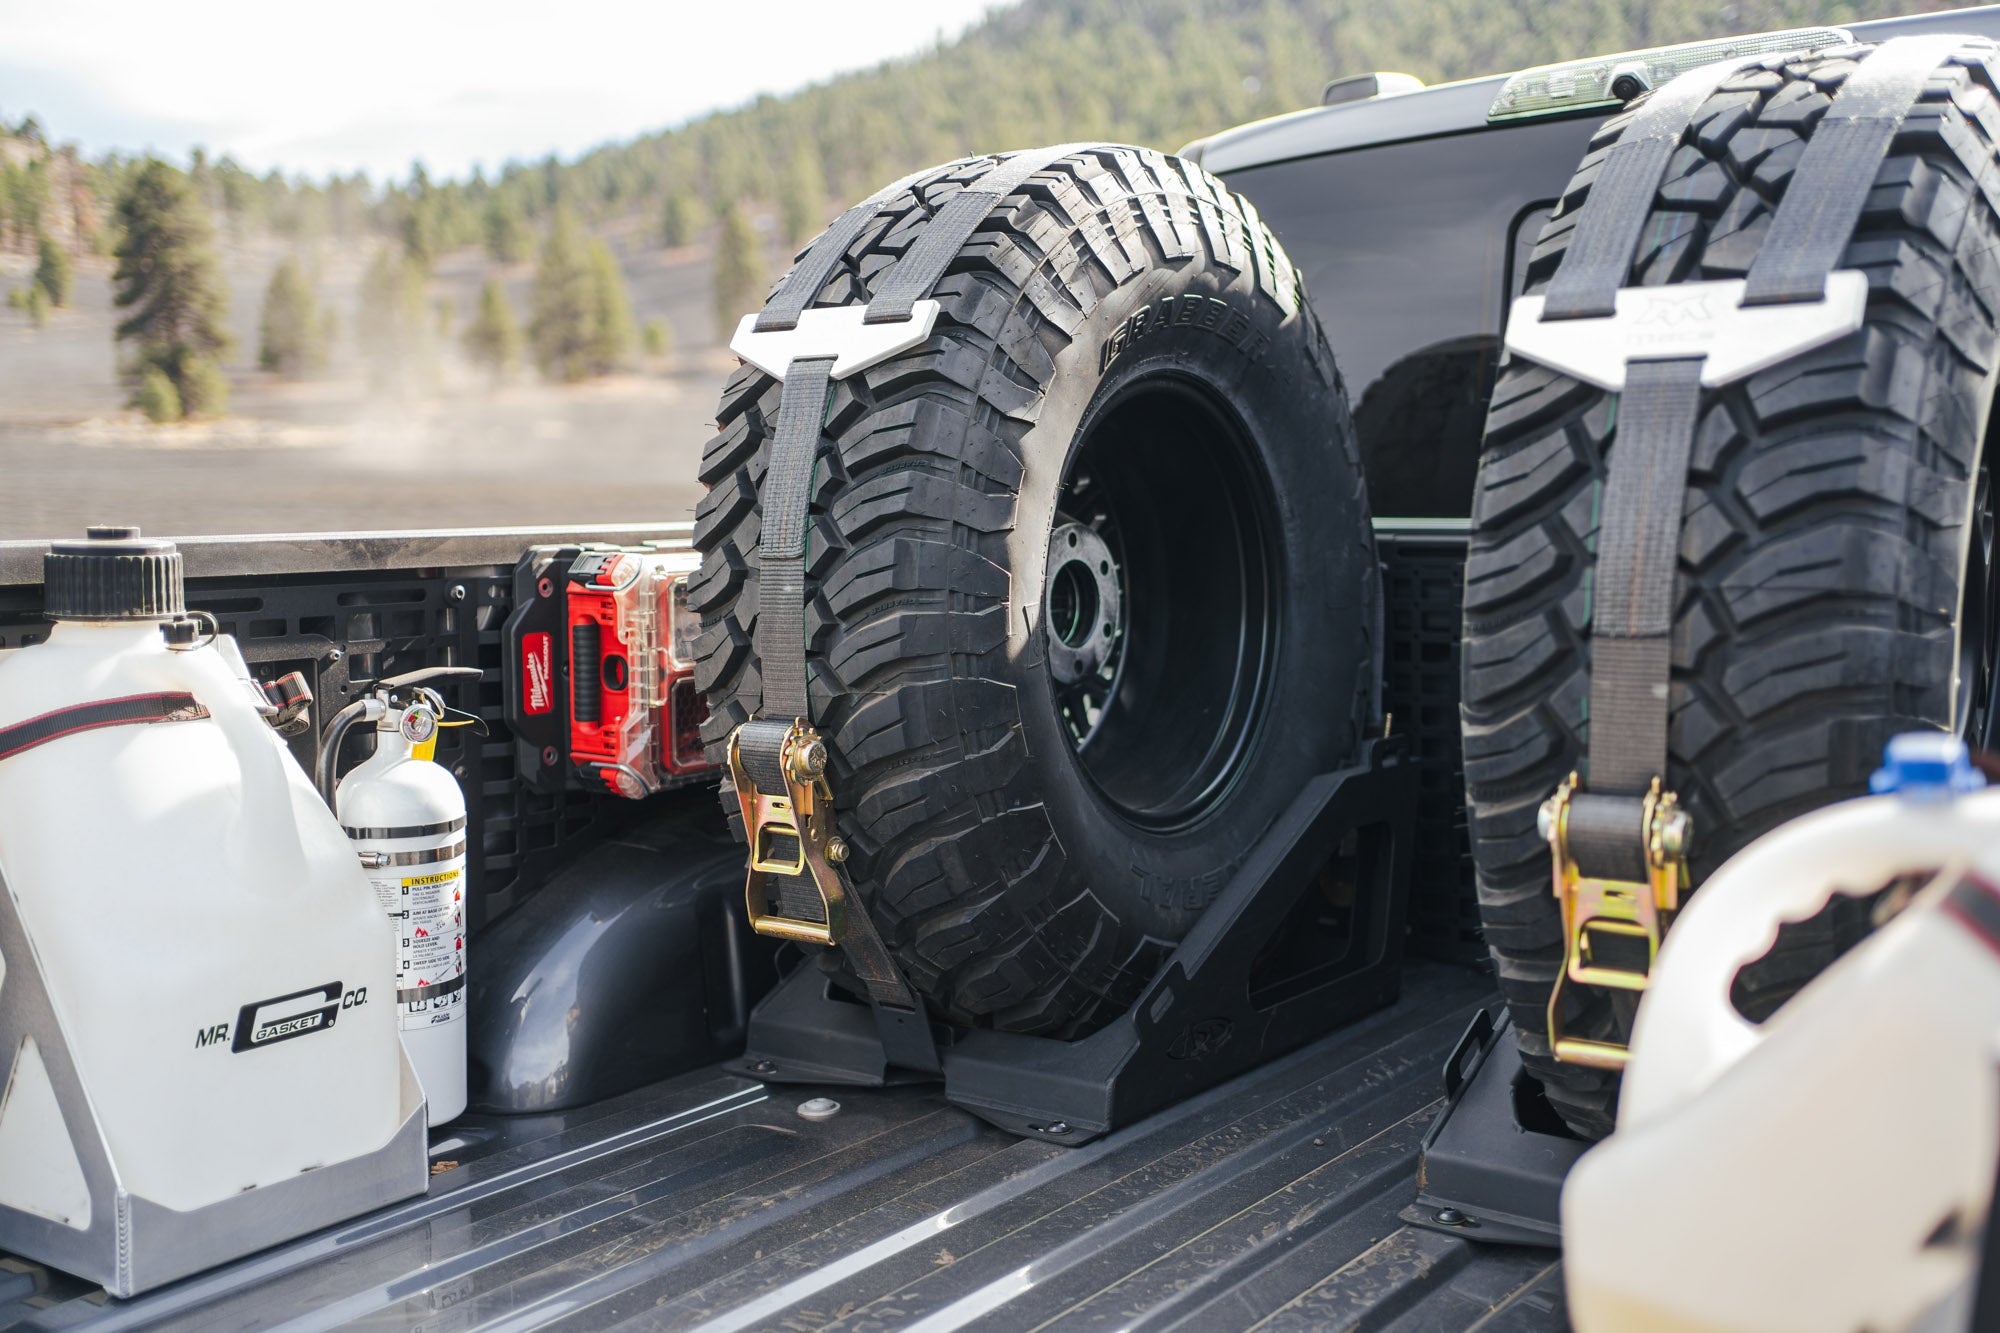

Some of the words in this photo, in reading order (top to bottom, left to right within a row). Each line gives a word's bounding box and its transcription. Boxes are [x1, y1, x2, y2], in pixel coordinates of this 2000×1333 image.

[1099, 293, 1272, 376] GRABBER
[195, 1023, 230, 1049] MR.
[256, 1014, 319, 1041] GASKET
[342, 986, 368, 1010] CO.
